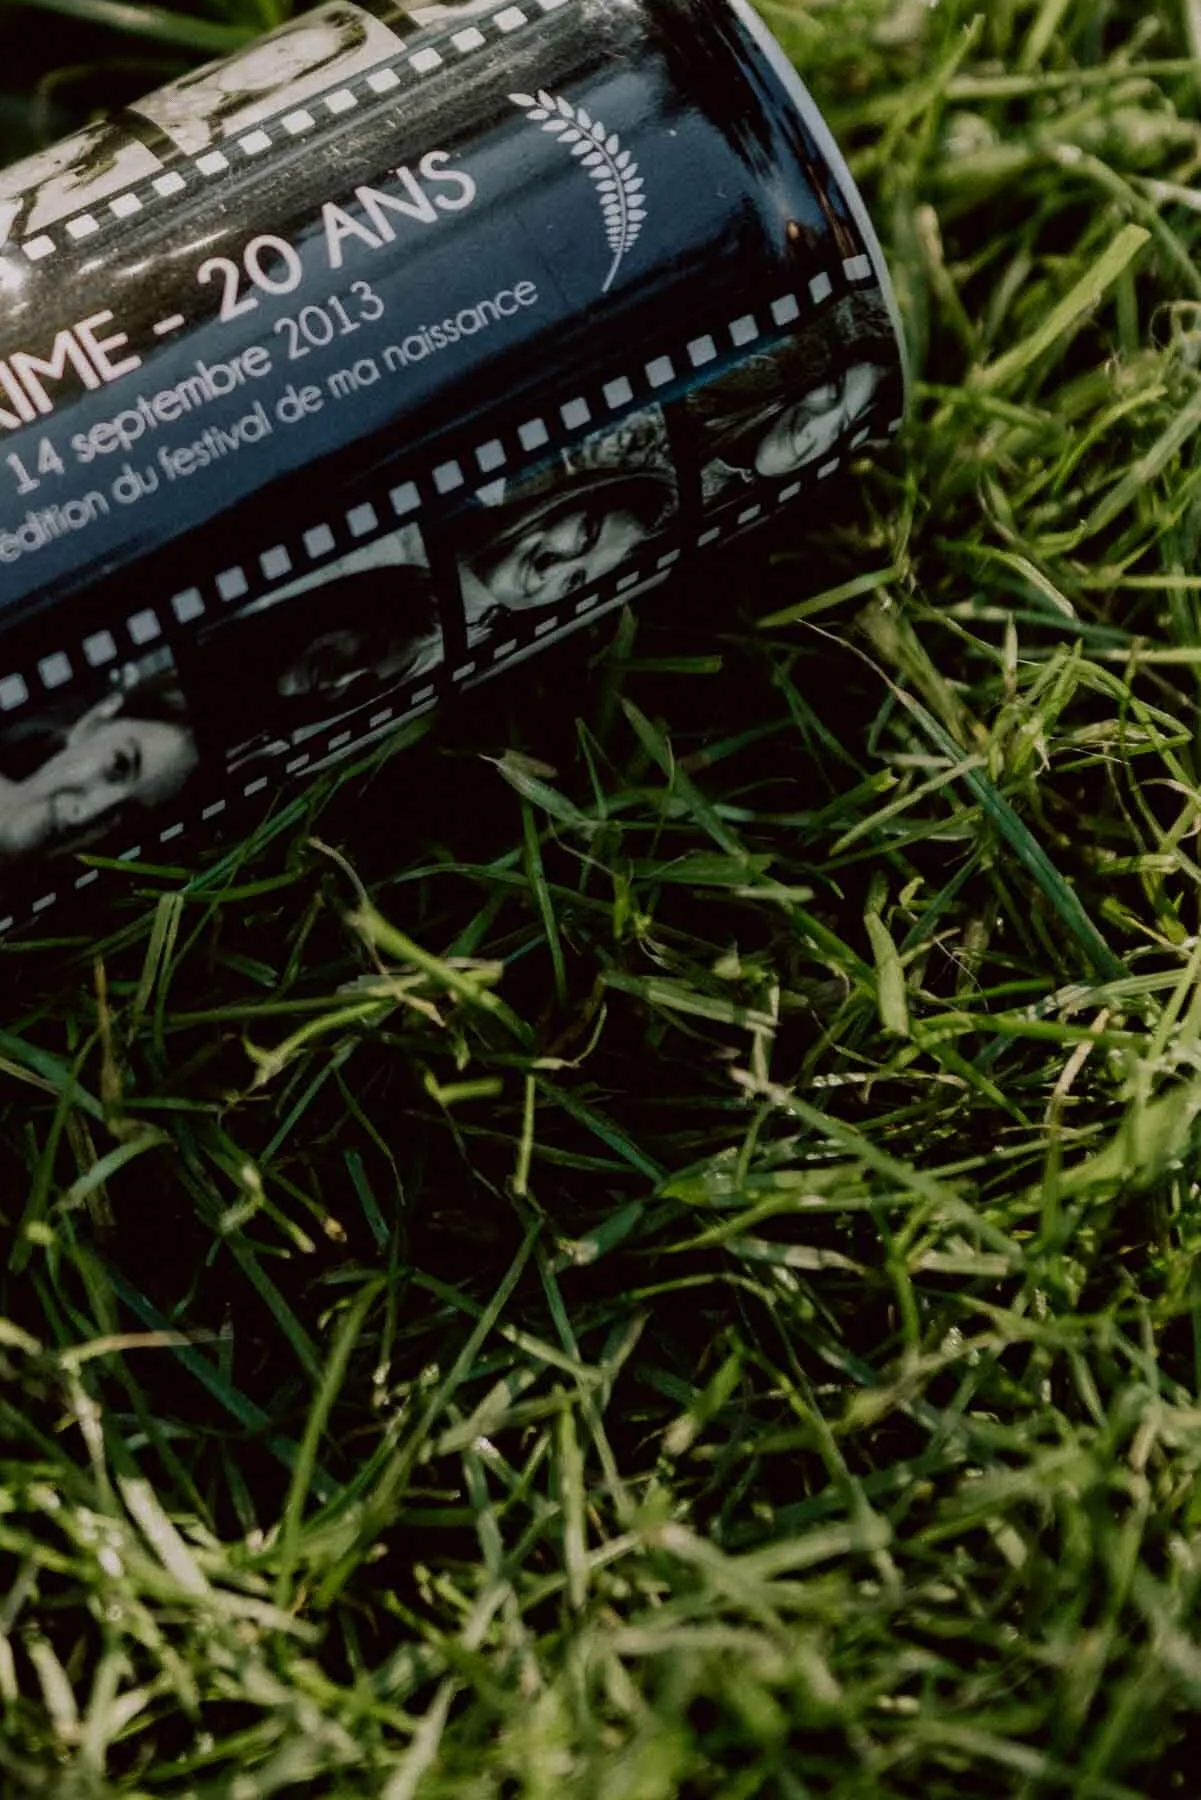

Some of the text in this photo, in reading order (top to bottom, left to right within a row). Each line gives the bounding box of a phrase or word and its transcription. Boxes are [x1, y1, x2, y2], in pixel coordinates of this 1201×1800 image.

[153, 313, 185, 335] -
[197, 234, 302, 323] 20
[322, 150, 476, 269] ANS
[6, 280, 384, 495] 14 septembre 2013
[111, 463, 159, 504] du
[158, 400, 273, 481] festival
[276, 384, 324, 423] de
[327, 359, 381, 398] ma
[383, 280, 538, 371] naissance
